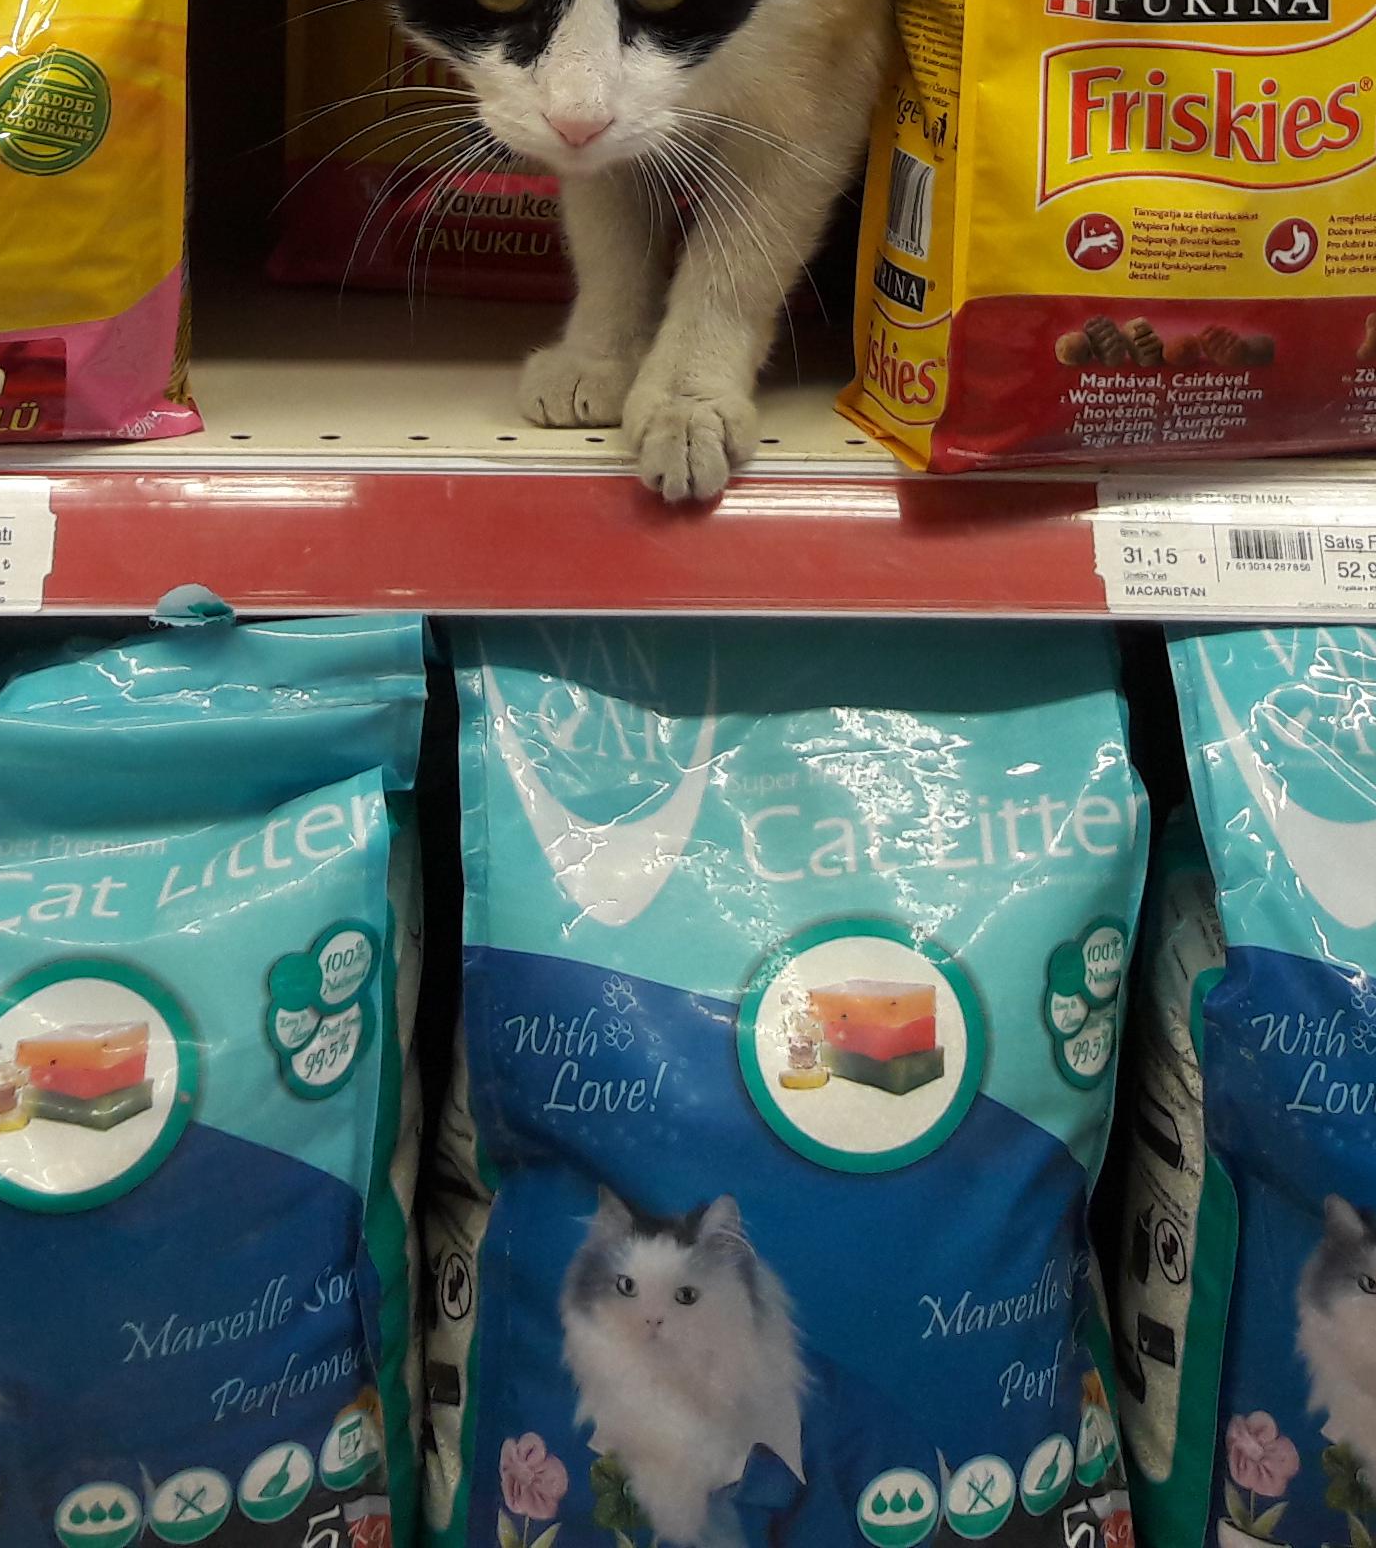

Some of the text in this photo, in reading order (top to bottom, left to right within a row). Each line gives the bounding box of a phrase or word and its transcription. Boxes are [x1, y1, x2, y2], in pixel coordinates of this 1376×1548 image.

[39, 91, 95, 113] ADDED
[1068, 65, 1361, 164] Friskies
[417, 227, 552, 255] TAVUKLU
[1123, 546, 1179, 566] 31,15
[1324, 534, 1364, 552] Satış
[1125, 585, 1206, 597] MACARISTAN
[156, 789, 389, 911] Litter
[743, 791, 1149, 883] Cat Litter
[503, 1010, 599, 1060] With
[1249, 1010, 1349, 1061] With
[543, 1067, 663, 1117] Love!
[120, 1274, 294, 1362] Marseille
[918, 1258, 1058, 1340] Marseille
